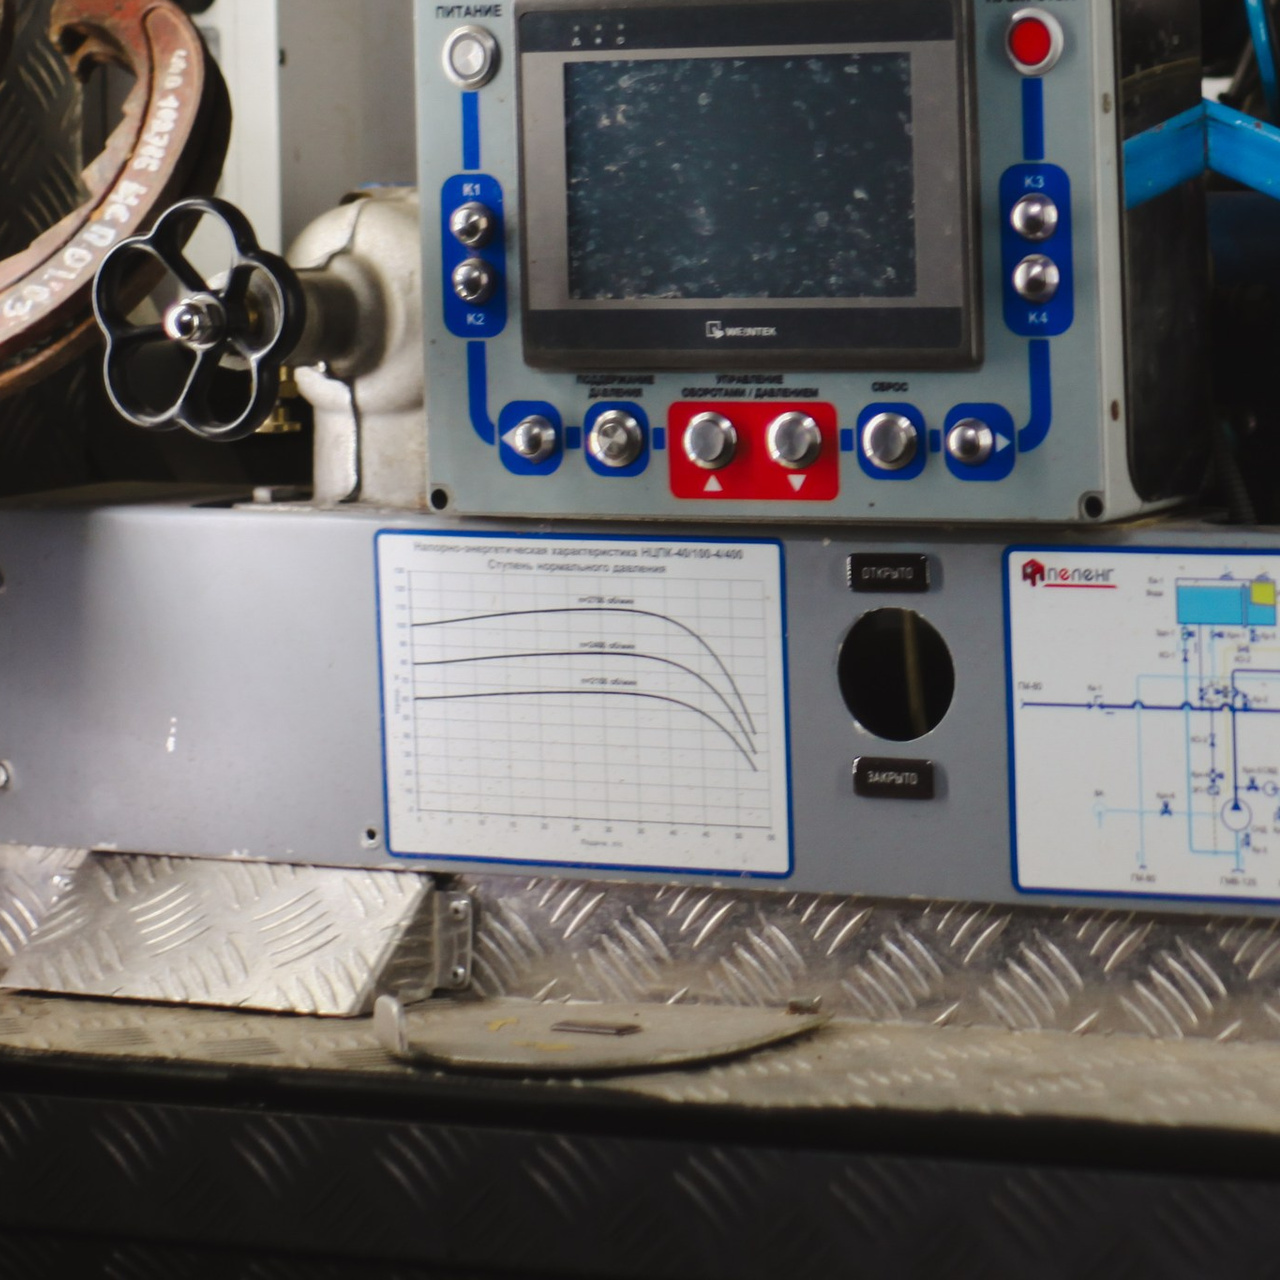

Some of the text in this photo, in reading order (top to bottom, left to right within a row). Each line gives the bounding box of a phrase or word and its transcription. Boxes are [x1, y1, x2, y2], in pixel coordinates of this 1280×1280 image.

[435, 4, 503, 19] ПИТАНИЕ
[871, 382, 909, 393] СБРОС
[861, 566, 915, 580] ОТКРЫТО
[867, 771, 919, 786] ЗАКРЫТО
